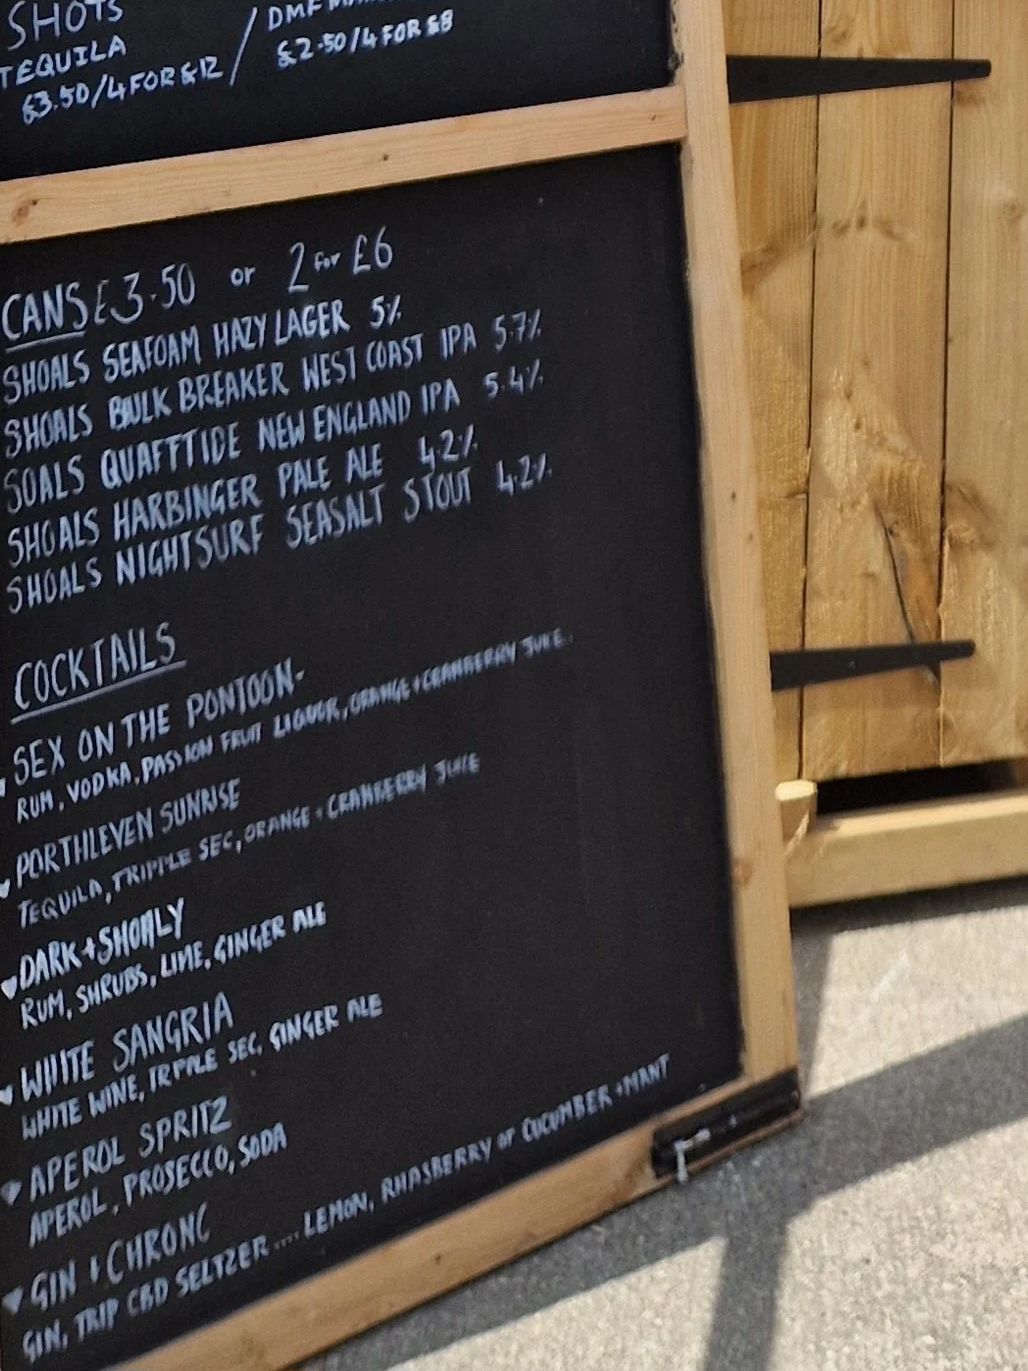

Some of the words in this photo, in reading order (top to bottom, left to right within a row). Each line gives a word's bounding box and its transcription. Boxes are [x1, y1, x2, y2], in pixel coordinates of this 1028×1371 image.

[0, 35, 127, 89] TEQUILA
[1, 281, 89, 341] CANS
[230, 266, 256, 286] or
[287, 242, 310, 294] 2
[352, 226, 393, 275] £6
[3, 349, 90, 406] SHOALS
[102, 325, 202, 383] SEAFOAM
[213, 313, 267, 359] HAZY
[274, 299, 351, 346] LAGER
[370, 294, 402, 329] 5%
[4, 403, 93, 459] SHOALS
[108, 386, 172, 431] BULK
[177, 361, 290, 414] BREAKER
[302, 346, 356, 393] WEST
[366, 333, 424, 373] COAST
[440, 322, 477, 360] IPA
[3, 454, 85, 515] SOALS
[257, 409, 305, 452] NEW
[312, 390, 411, 442] ENGLAND
[420, 378, 461, 415] IPA
[6, 556, 102, 615] SHOALS
[285, 483, 387, 550] SEASALT
[403, 466, 472, 524] STOUT
[7, 506, 100, 569] SHOALS
[113, 473, 263, 542] HARBINGER
[277, 455, 331, 500] PALE
[345, 442, 383, 485] ALE
[13, 621, 176, 711] COCKTAILS
[12, 734, 67, 786] SEX
[78, 721, 114, 763] ON
[121, 702, 171, 749] THE
[220, 721, 262, 754] FRUIT
[16, 807, 154, 888] PORTHLEVEN
[159, 778, 241, 834] SUNRISE
[243, 806, 311, 843] ORANGE
[19, 938, 83, 991] DARK
[213, 914, 287, 965] GINGER
[291, 901, 327, 933] ALE
[20, 1039, 95, 1102] WHITE
[111, 991, 234, 1073] SANGRIA
[22, 1096, 83, 1141] WHITE
[269, 1003, 340, 1052] GINGER
[346, 992, 383, 1022] ALE
[30, 1136, 125, 1203] APEROL
[138, 1095, 233, 1158] SPRITZ
[237, 1121, 287, 1167] SODA
[30, 1259, 77, 1311] GIN
[74, 1297, 119, 1341] TRIP
[126, 1277, 169, 1317] CBD
